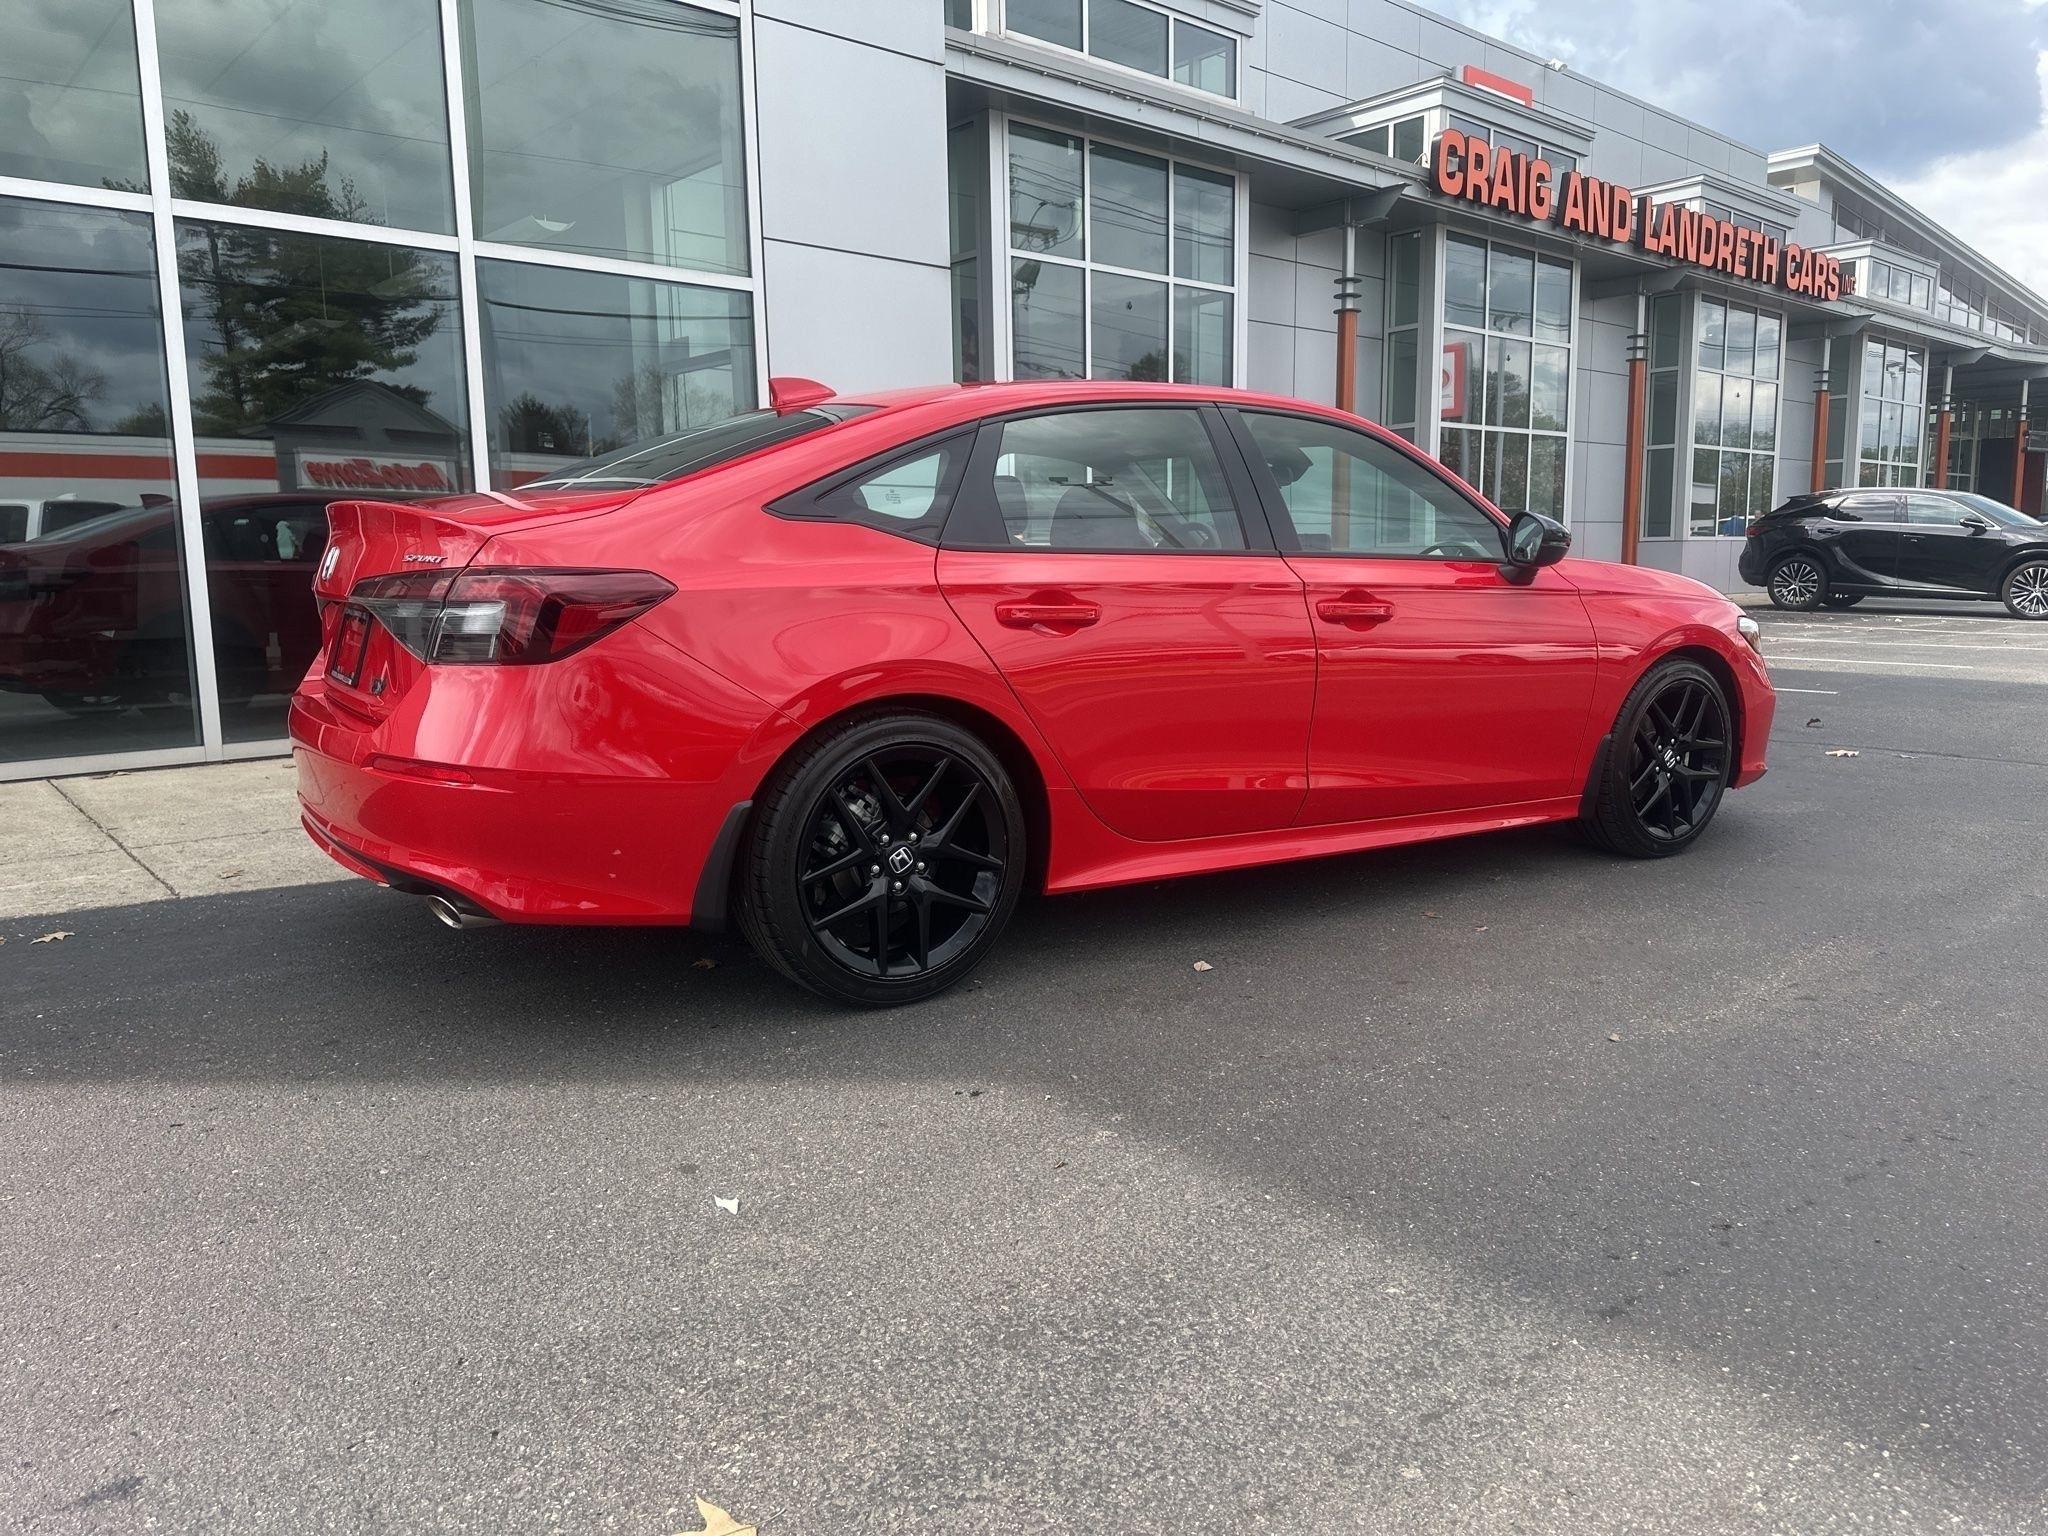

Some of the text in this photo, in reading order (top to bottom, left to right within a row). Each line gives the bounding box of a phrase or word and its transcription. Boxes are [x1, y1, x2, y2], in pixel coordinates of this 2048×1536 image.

[1438, 128, 1553, 220] CRAIG
[1563, 171, 1632, 243] AND
[1643, 196, 1779, 285] LANDRETH
[1786, 243, 1840, 301] CARS
[402, 554, 448, 563] SPORT
